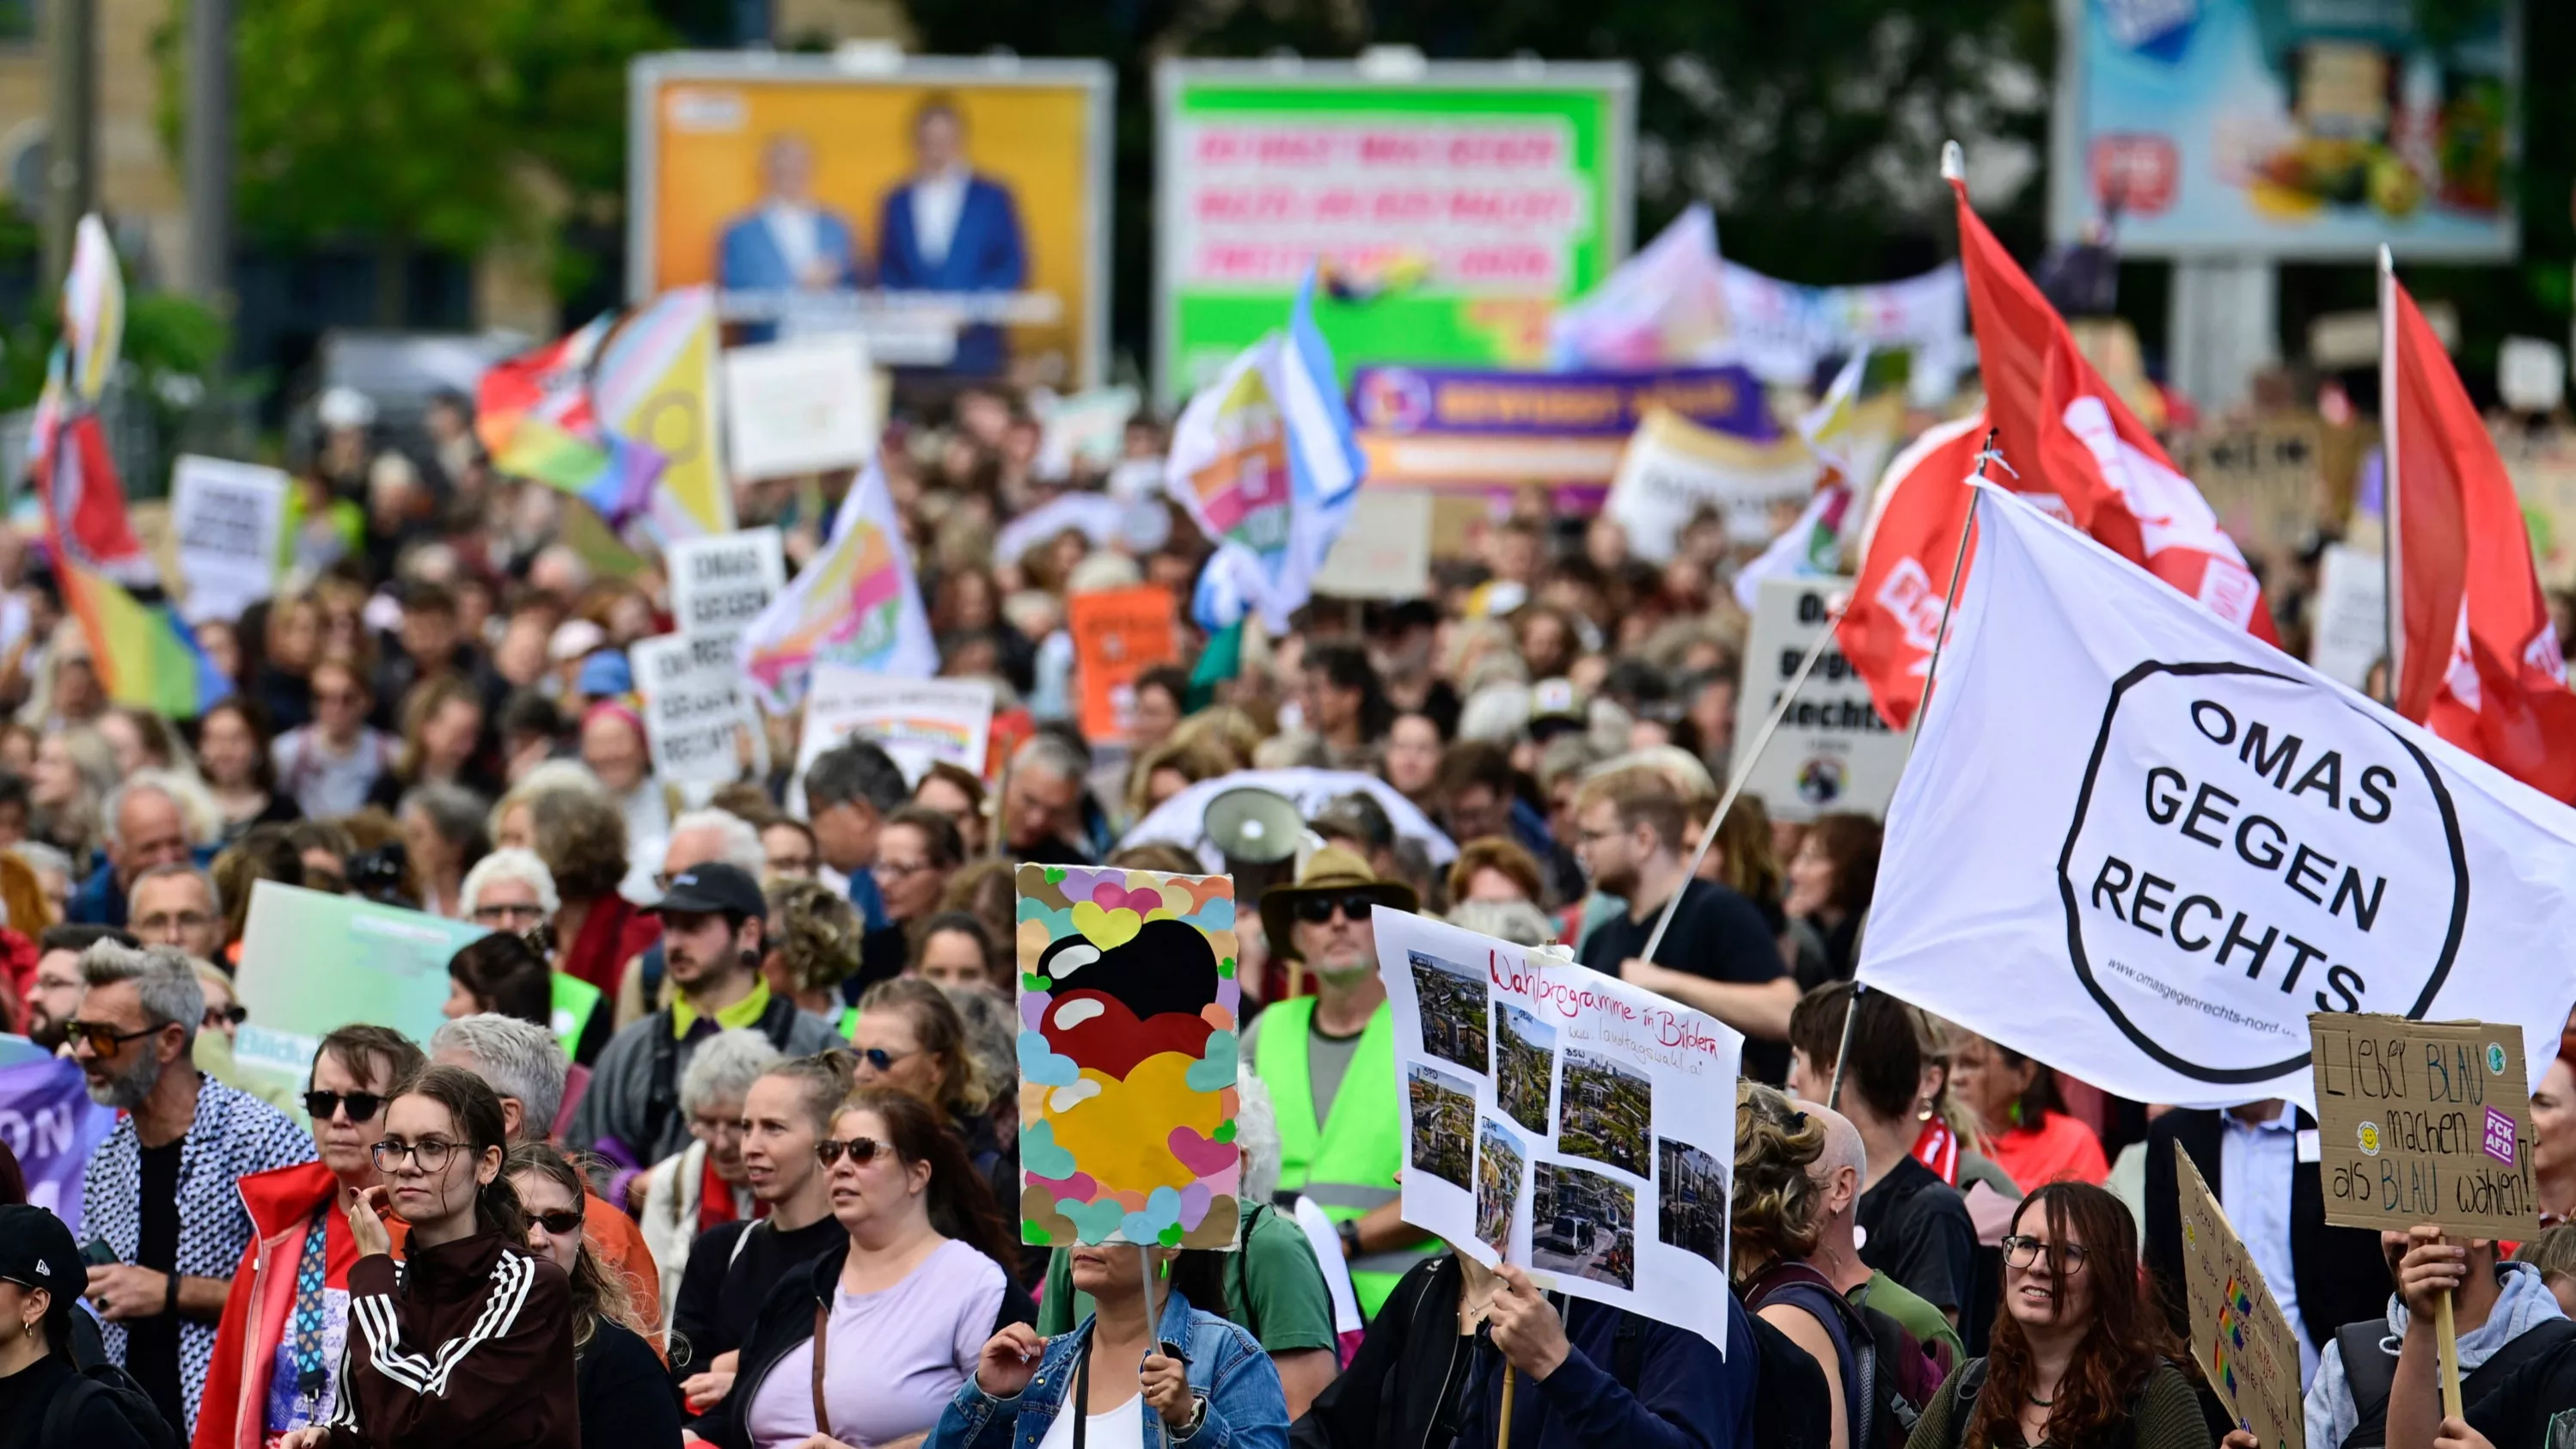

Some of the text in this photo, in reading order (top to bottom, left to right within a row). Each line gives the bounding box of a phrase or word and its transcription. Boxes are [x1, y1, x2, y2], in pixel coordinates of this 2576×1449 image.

[2191, 699, 2397, 824] OMAS
[2145, 766, 2387, 933] GEGEN
[2091, 854, 2365, 1014] RECHTS
[1489, 948, 1718, 1061] Wahlprogramme in Bildern
[1565, 1048, 1586, 1059] BSW
[2322, 1029, 2408, 1100] Lieber
[2426, 1042, 2484, 1106] BLAU
[2386, 1109, 2475, 1159] machen,
[2484, 1133, 2512, 1157] AFD
[2486, 1116, 2513, 1142] FCK
[2333, 1137, 2531, 1217] als BLAU wählen!
[2235, 1259, 2253, 1299] den
